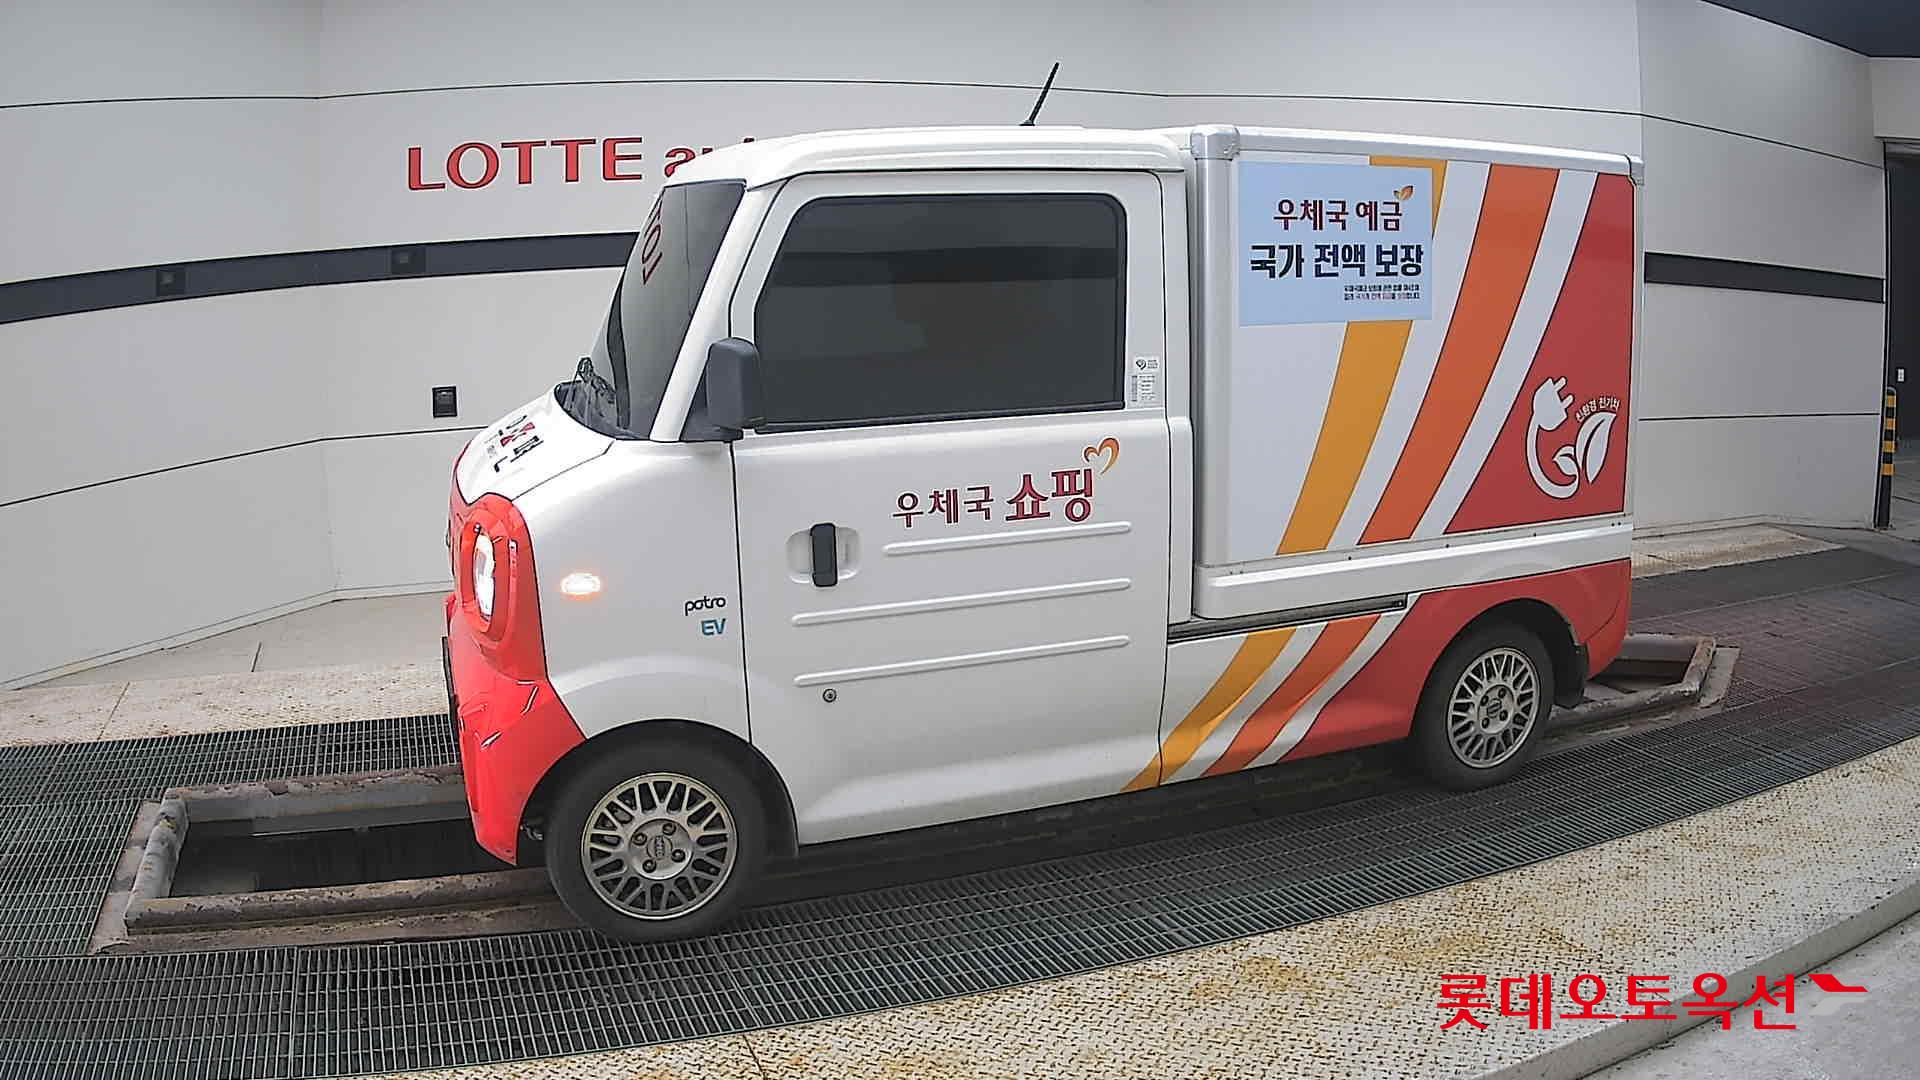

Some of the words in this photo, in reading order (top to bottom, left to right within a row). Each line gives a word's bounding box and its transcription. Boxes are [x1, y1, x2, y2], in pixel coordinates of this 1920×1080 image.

[407, 136, 643, 191] LOTTE
[1273, 199, 1349, 231] 우체국
[1355, 200, 1402, 231] 예금
[1250, 244, 1304, 279] 국가
[1314, 243, 1366, 278] 전액
[1375, 243, 1424, 277] 보장
[892, 485, 994, 528] 우체국
[1005, 468, 1093, 523] 쇼핑
[701, 618, 726, 635] EV
